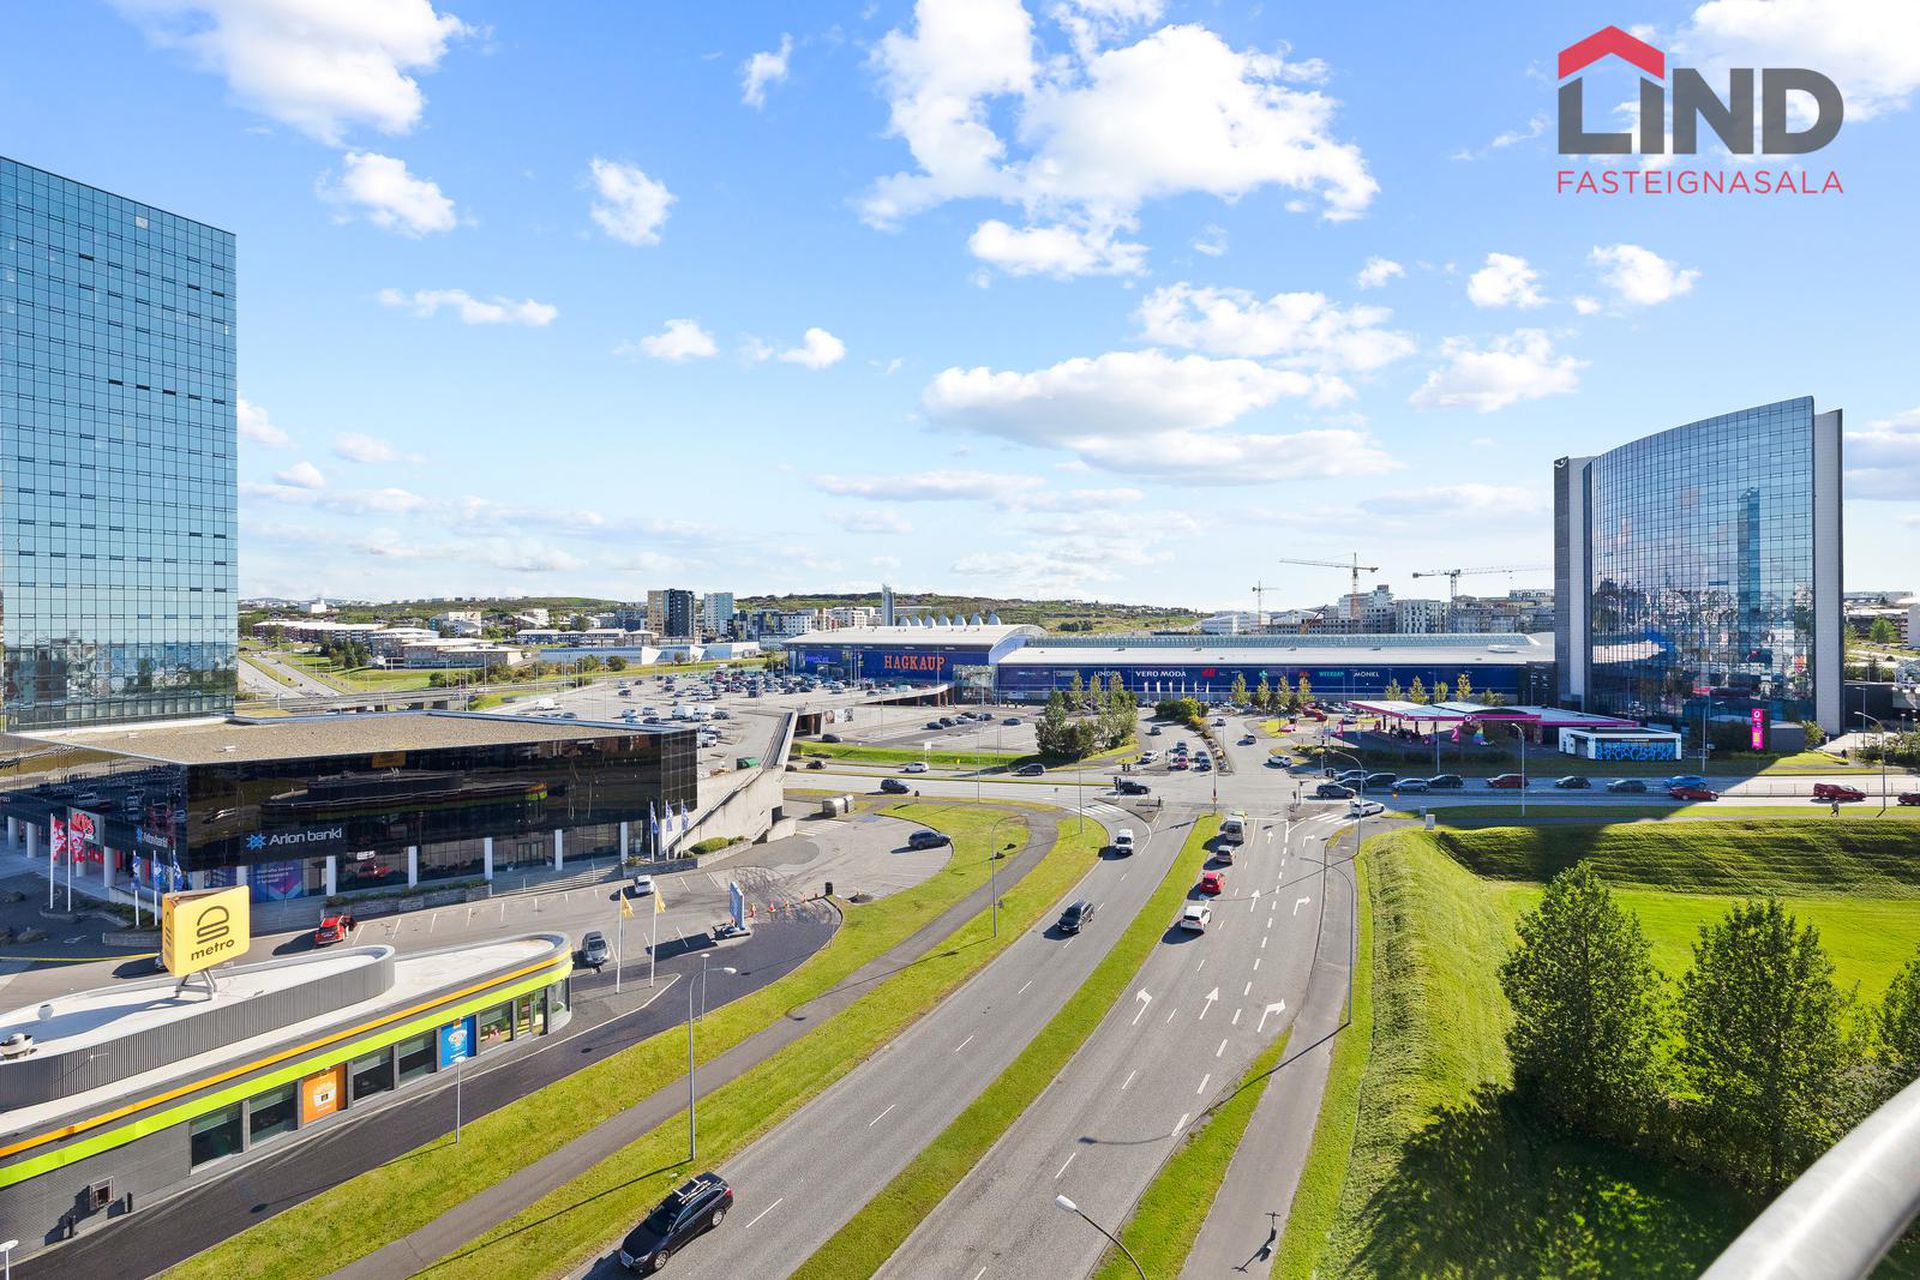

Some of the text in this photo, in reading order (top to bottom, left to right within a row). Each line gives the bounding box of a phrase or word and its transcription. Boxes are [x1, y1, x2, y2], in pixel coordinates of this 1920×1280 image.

[884, 655, 946, 671] HAGKAUP
[1135, 670, 1187, 678] VERO MODA
[268, 828, 342, 846] Arion banki
[191, 939, 235, 961] metro
